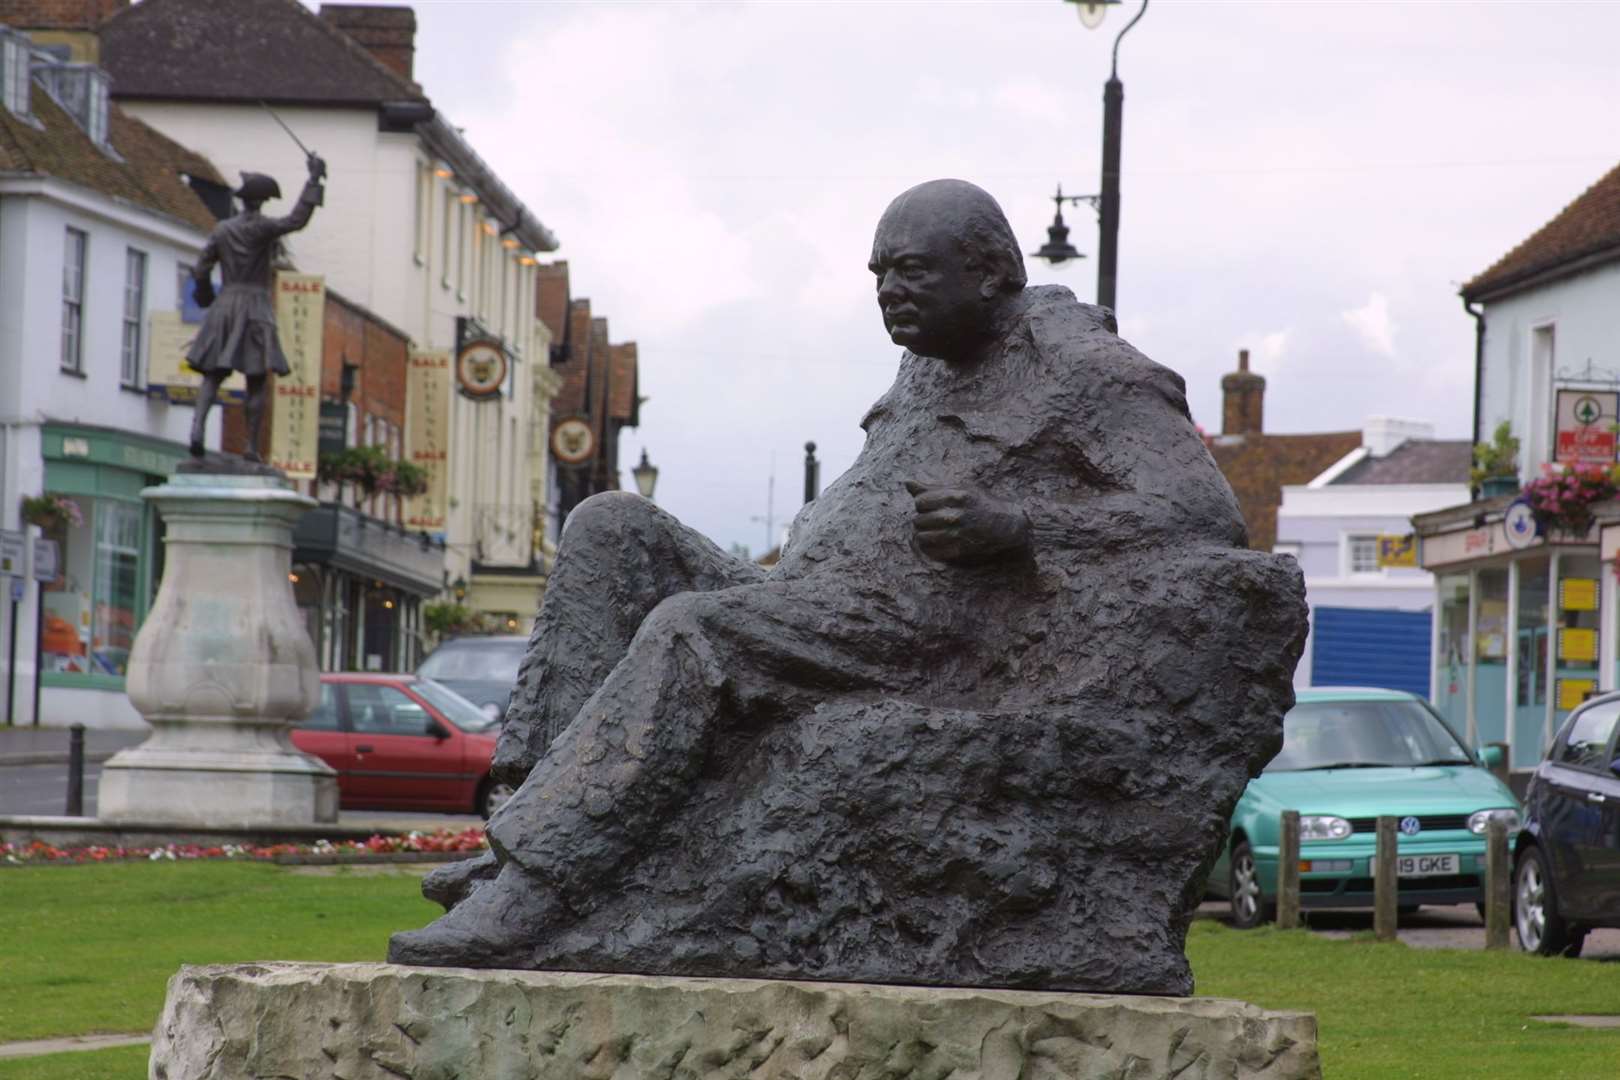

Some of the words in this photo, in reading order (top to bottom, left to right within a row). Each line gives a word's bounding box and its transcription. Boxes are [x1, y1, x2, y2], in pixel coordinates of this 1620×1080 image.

[281, 281, 321, 293] SALE
[412, 357, 449, 368] SALE
[277, 385, 316, 398] SALE
[413, 450, 448, 461] SALE
[273, 461, 314, 473] SALE
[1420, 856, 1452, 873] GKE
